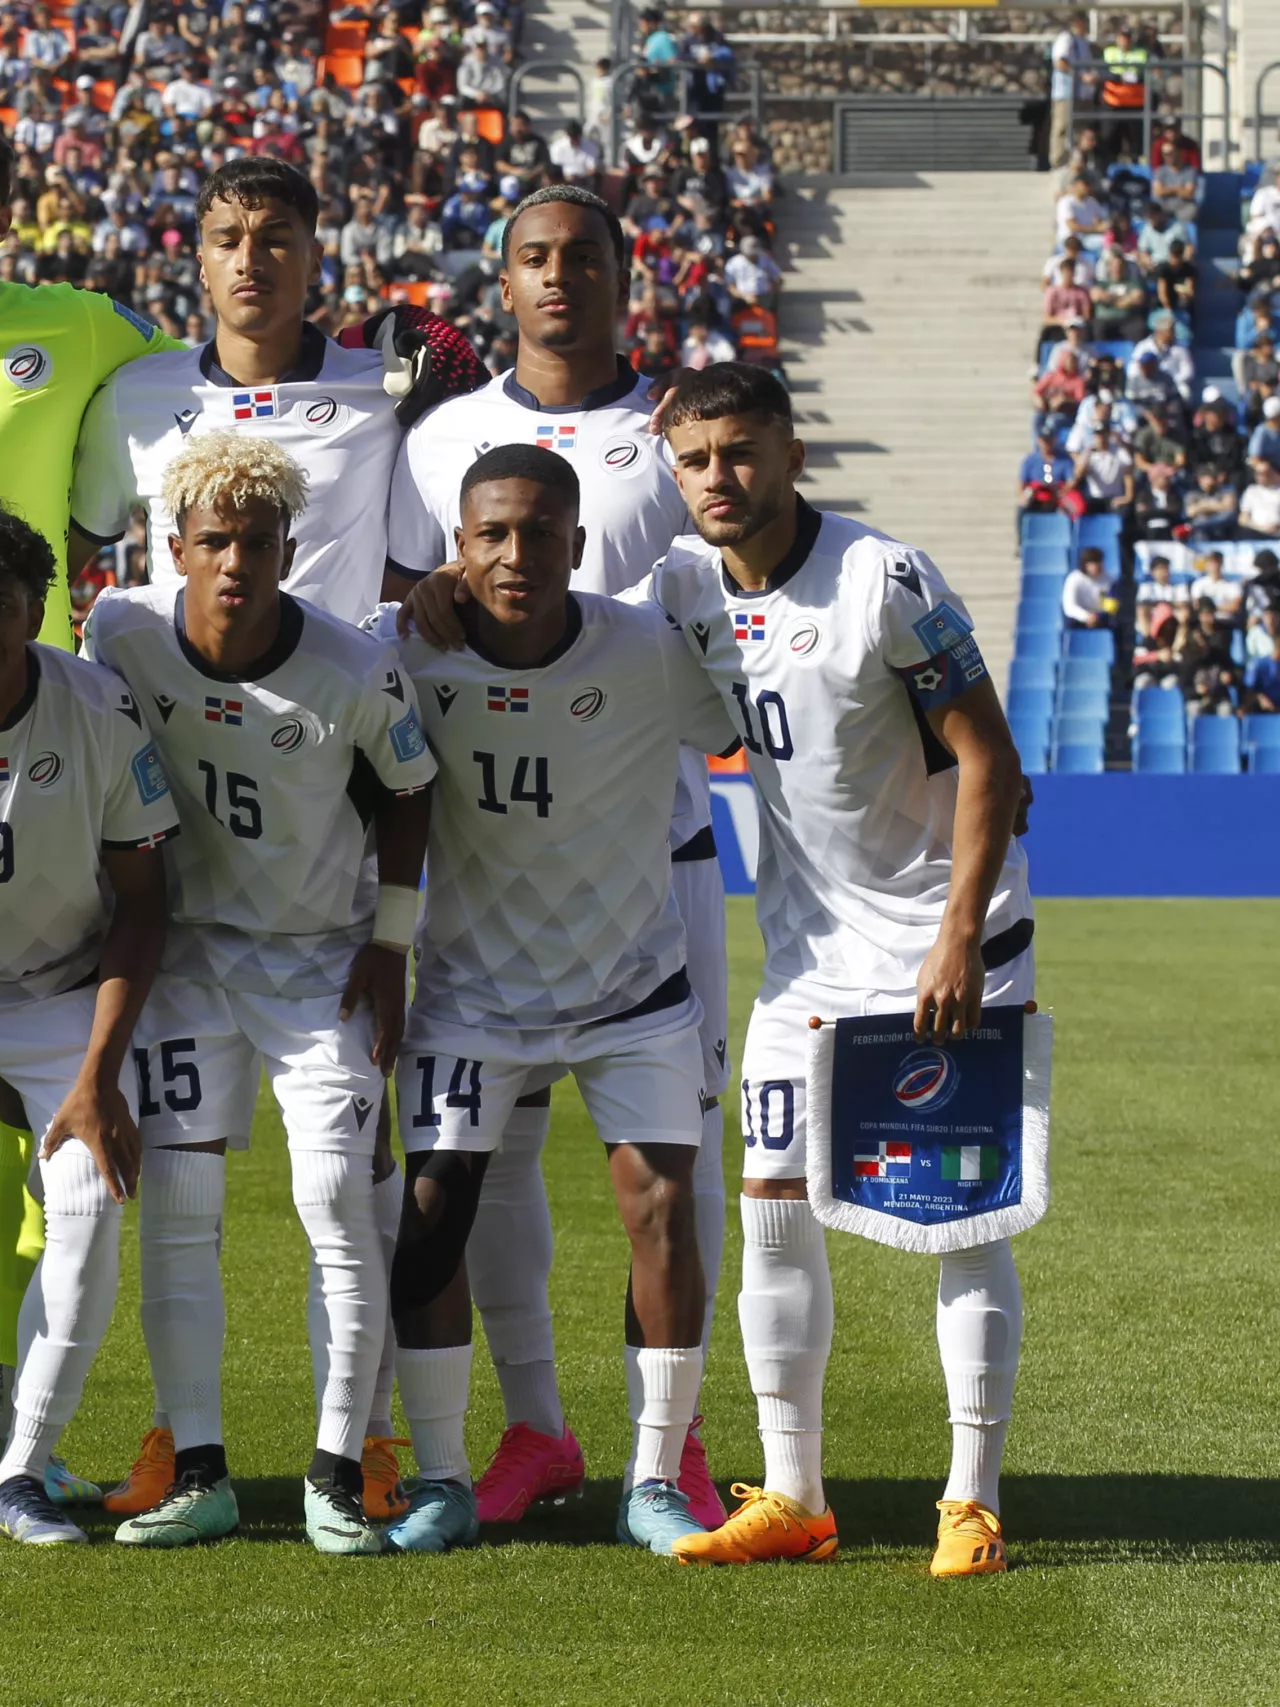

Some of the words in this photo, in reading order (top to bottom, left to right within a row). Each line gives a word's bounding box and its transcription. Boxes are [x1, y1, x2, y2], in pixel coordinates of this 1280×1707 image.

[731, 680, 795, 761] 10
[197, 758, 264, 841] 15
[472, 749, 554, 819] 14
[134, 1037, 203, 1117] 15
[411, 1055, 484, 1129] 14
[741, 1078, 795, 1151] 10
[859, 1121, 878, 1130] COPA
[878, 1121, 910, 1131] MUNDIAL
[910, 1123, 925, 1132] FIFA
[954, 1124, 994, 1135] ARGENTINA
[909, 1193, 931, 1202] MAYO
[932, 1195, 953, 1203] 2023
[920, 1158, 932, 1168] VS
[957, 1180, 983, 1188] NIGERIA
[924, 1202, 969, 1212] ARGENTINA
